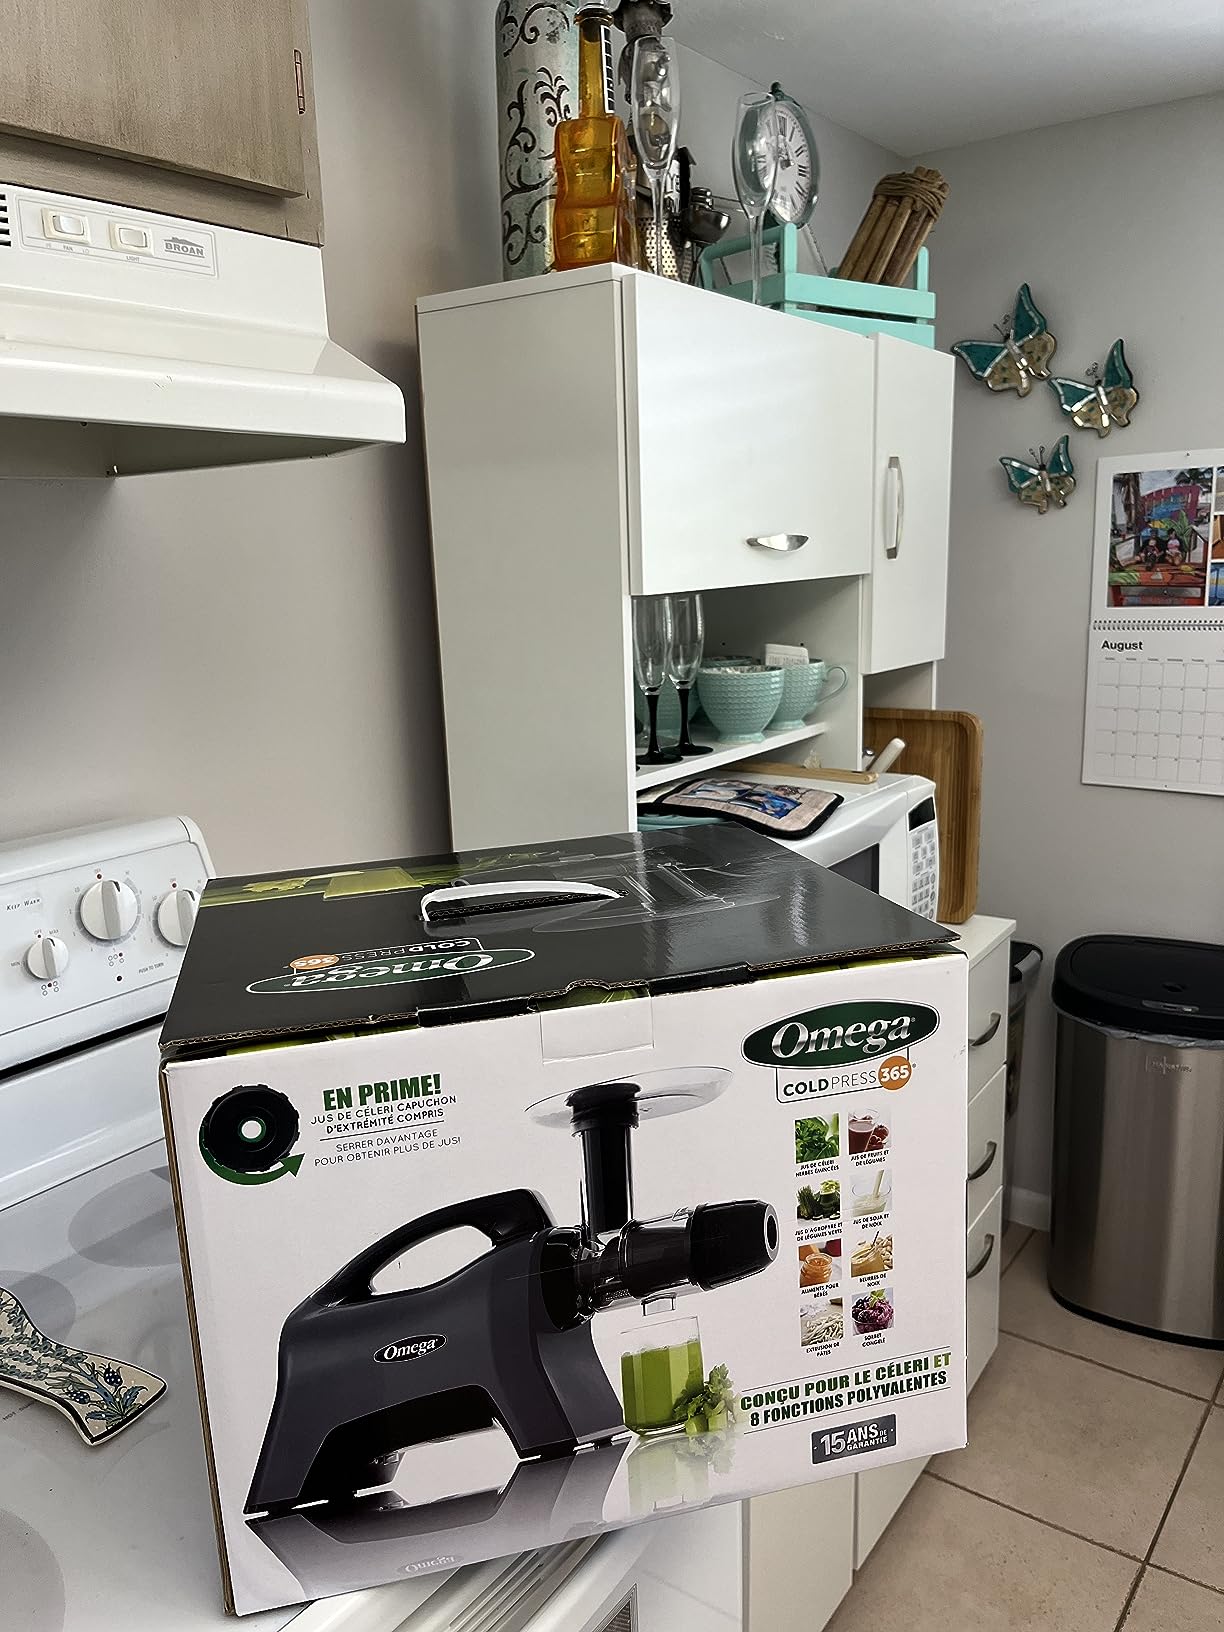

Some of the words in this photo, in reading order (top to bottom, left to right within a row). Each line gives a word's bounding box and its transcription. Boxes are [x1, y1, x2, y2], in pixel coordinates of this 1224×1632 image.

[165, 242, 204, 257] BROAN
[1101, 640, 1143, 652] August
[290, 953, 494, 987] Omega
[771, 1014, 911, 1059] Omega
[880, 1064, 910, 1083] 365
[322, 1087, 353, 1111] EN
[358, 1073, 442, 1107] PRIME!
[311, 1113, 334, 1125] JUS
[337, 1111, 352, 1121] DE
[355, 1105, 394, 1119] CÉLERI
[397, 1095, 457, 1112] CAPUCHON
[326, 1114, 394, 1134] D'EXTRÉMITÉ
[397, 1108, 445, 1123] COMPRIS
[314, 1154, 344, 1167] POUR
[347, 1148, 391, 1162] OBTENIR
[393, 1143, 420, 1155] PLUS
[422, 1140, 435, 1150] DE
[438, 1137, 462, 1148] JUS!
[336, 1139, 374, 1153] SERRER
[376, 1129, 438, 1147] DAVANTAGE
[384, 1338, 437, 1360] Omega
[740, 1385, 800, 1411] CONÇU
[804, 1374, 850, 1398] POUR
[854, 1369, 872, 1386] LE
[875, 1356, 930, 1381] CÉLERI
[933, 1352, 952, 1369] ET
[750, 1412, 760, 1427] 8
[763, 1394, 844, 1424] FONCTIONS
[847, 1370, 947, 1405] POLYVALENTES
[820, 1430, 846, 1456] 15
[846, 1423, 879, 1444] ANS
[879, 1429, 888, 1437] DE
[846, 1435, 889, 1451] GARANTIE
